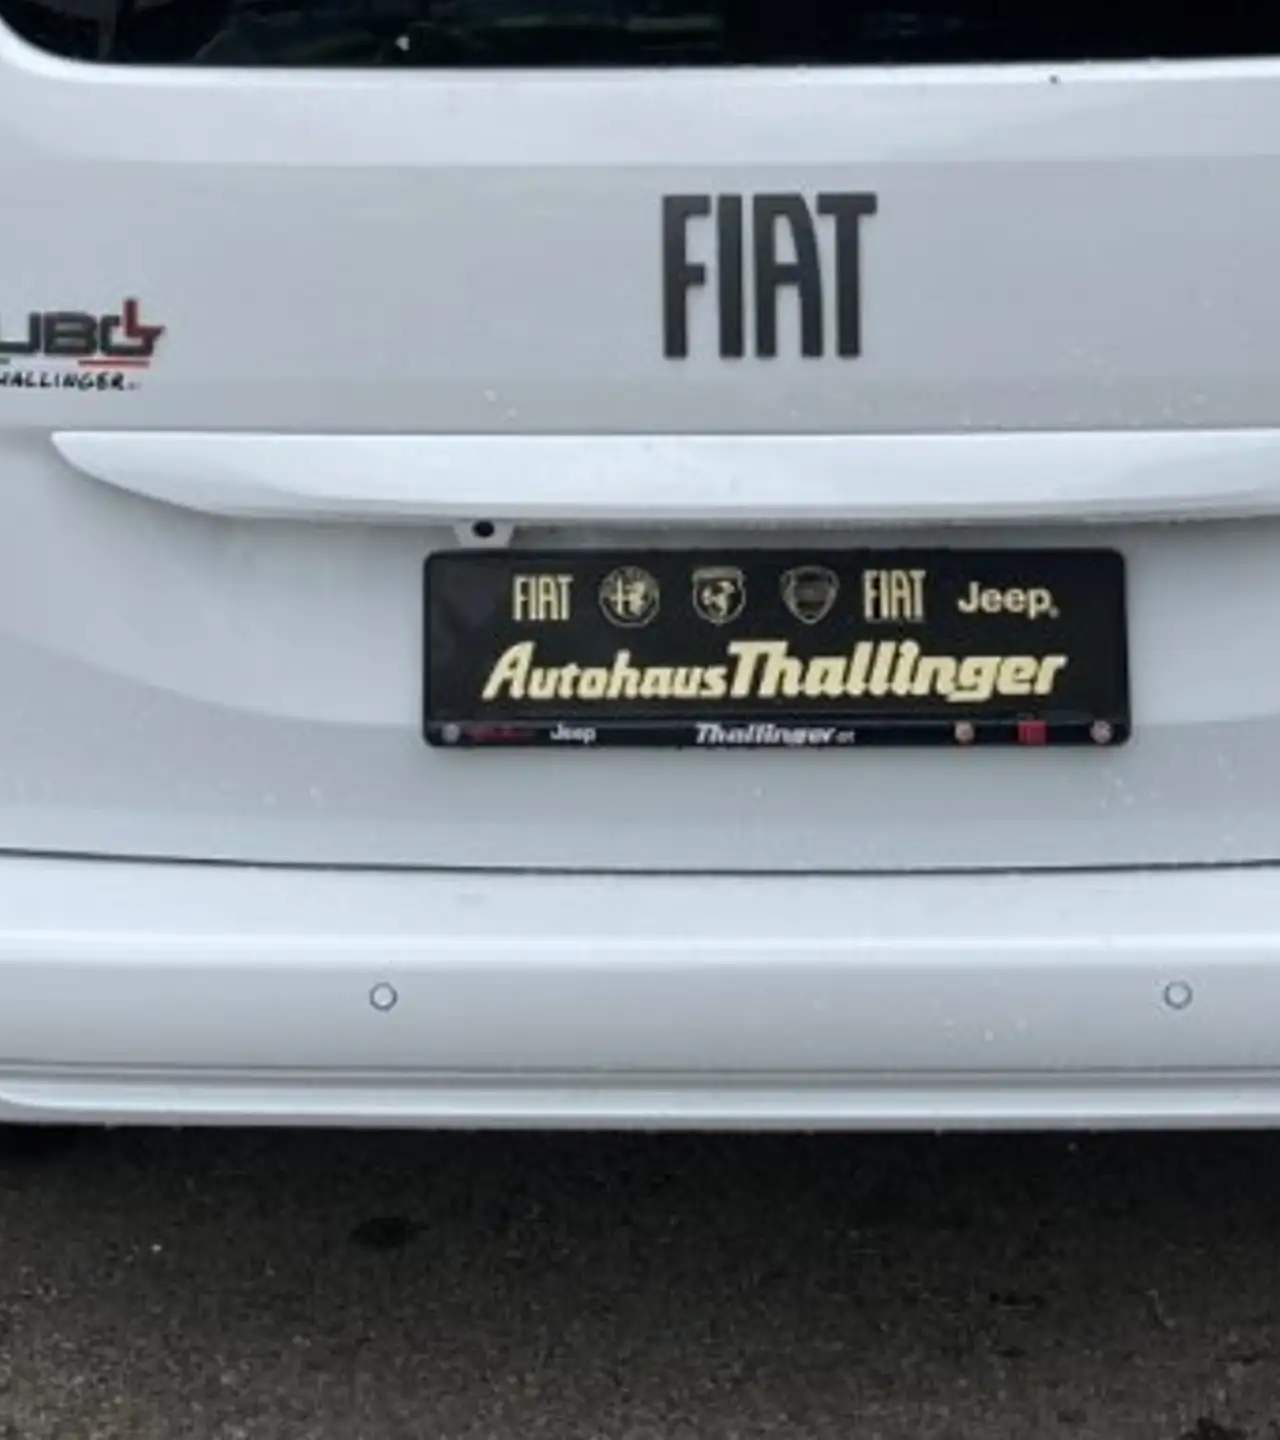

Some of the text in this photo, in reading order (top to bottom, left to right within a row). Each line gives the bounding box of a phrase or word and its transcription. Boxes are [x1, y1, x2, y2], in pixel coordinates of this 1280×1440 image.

[662, 190, 878, 360] FIAT
[512, 573, 575, 623] FIAT
[862, 568, 927, 623] FIAT
[957, 580, 1055, 619] Jeep
